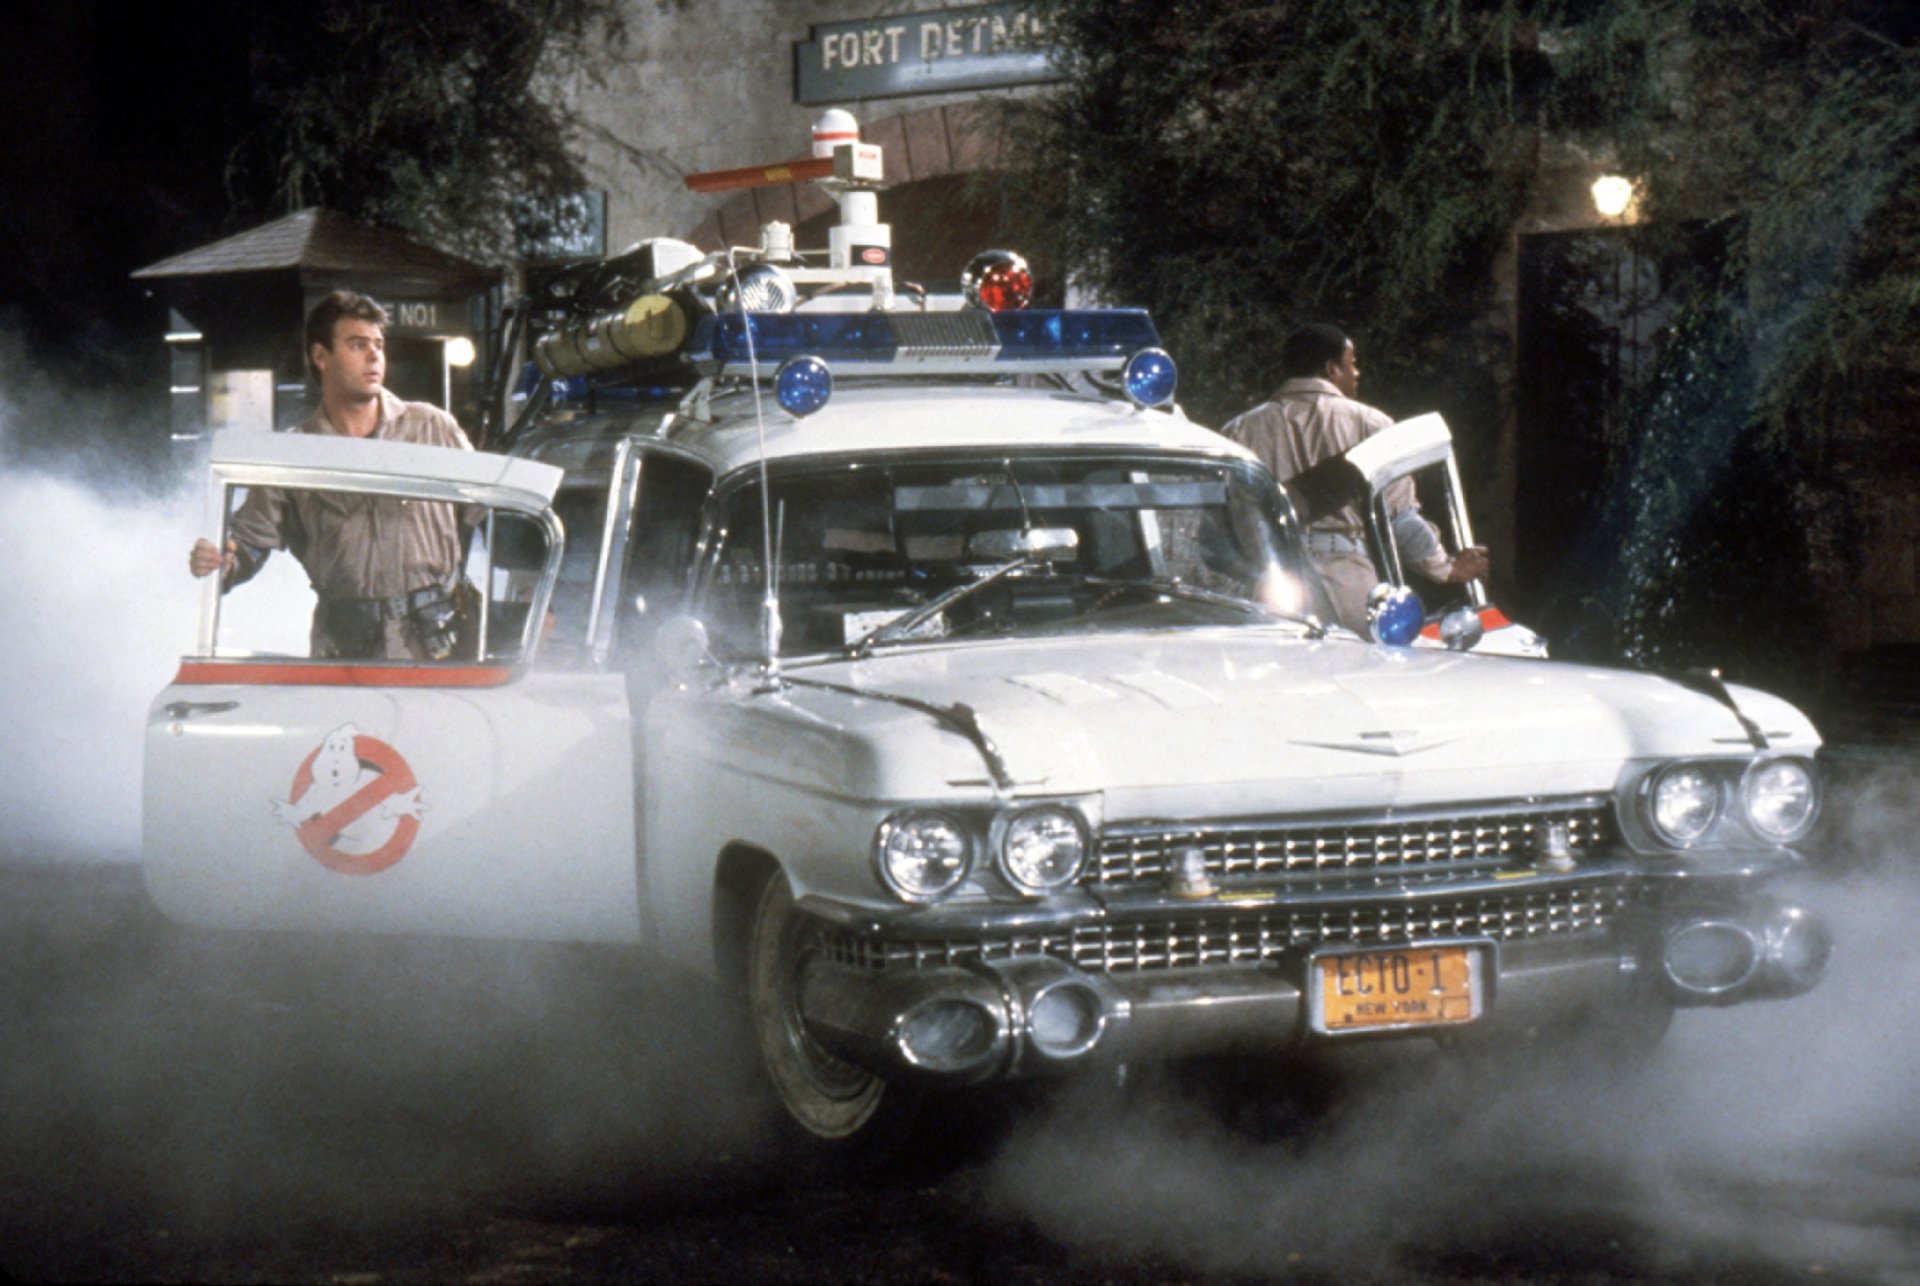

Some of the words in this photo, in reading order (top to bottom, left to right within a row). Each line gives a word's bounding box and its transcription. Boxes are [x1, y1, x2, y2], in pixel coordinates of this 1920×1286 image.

[822, 26, 905, 70] FORT
[920, 12, 1047, 60] DETM
[1356, 1002, 1386, 1015] NEW
[1393, 1000, 1427, 1013] YORK
